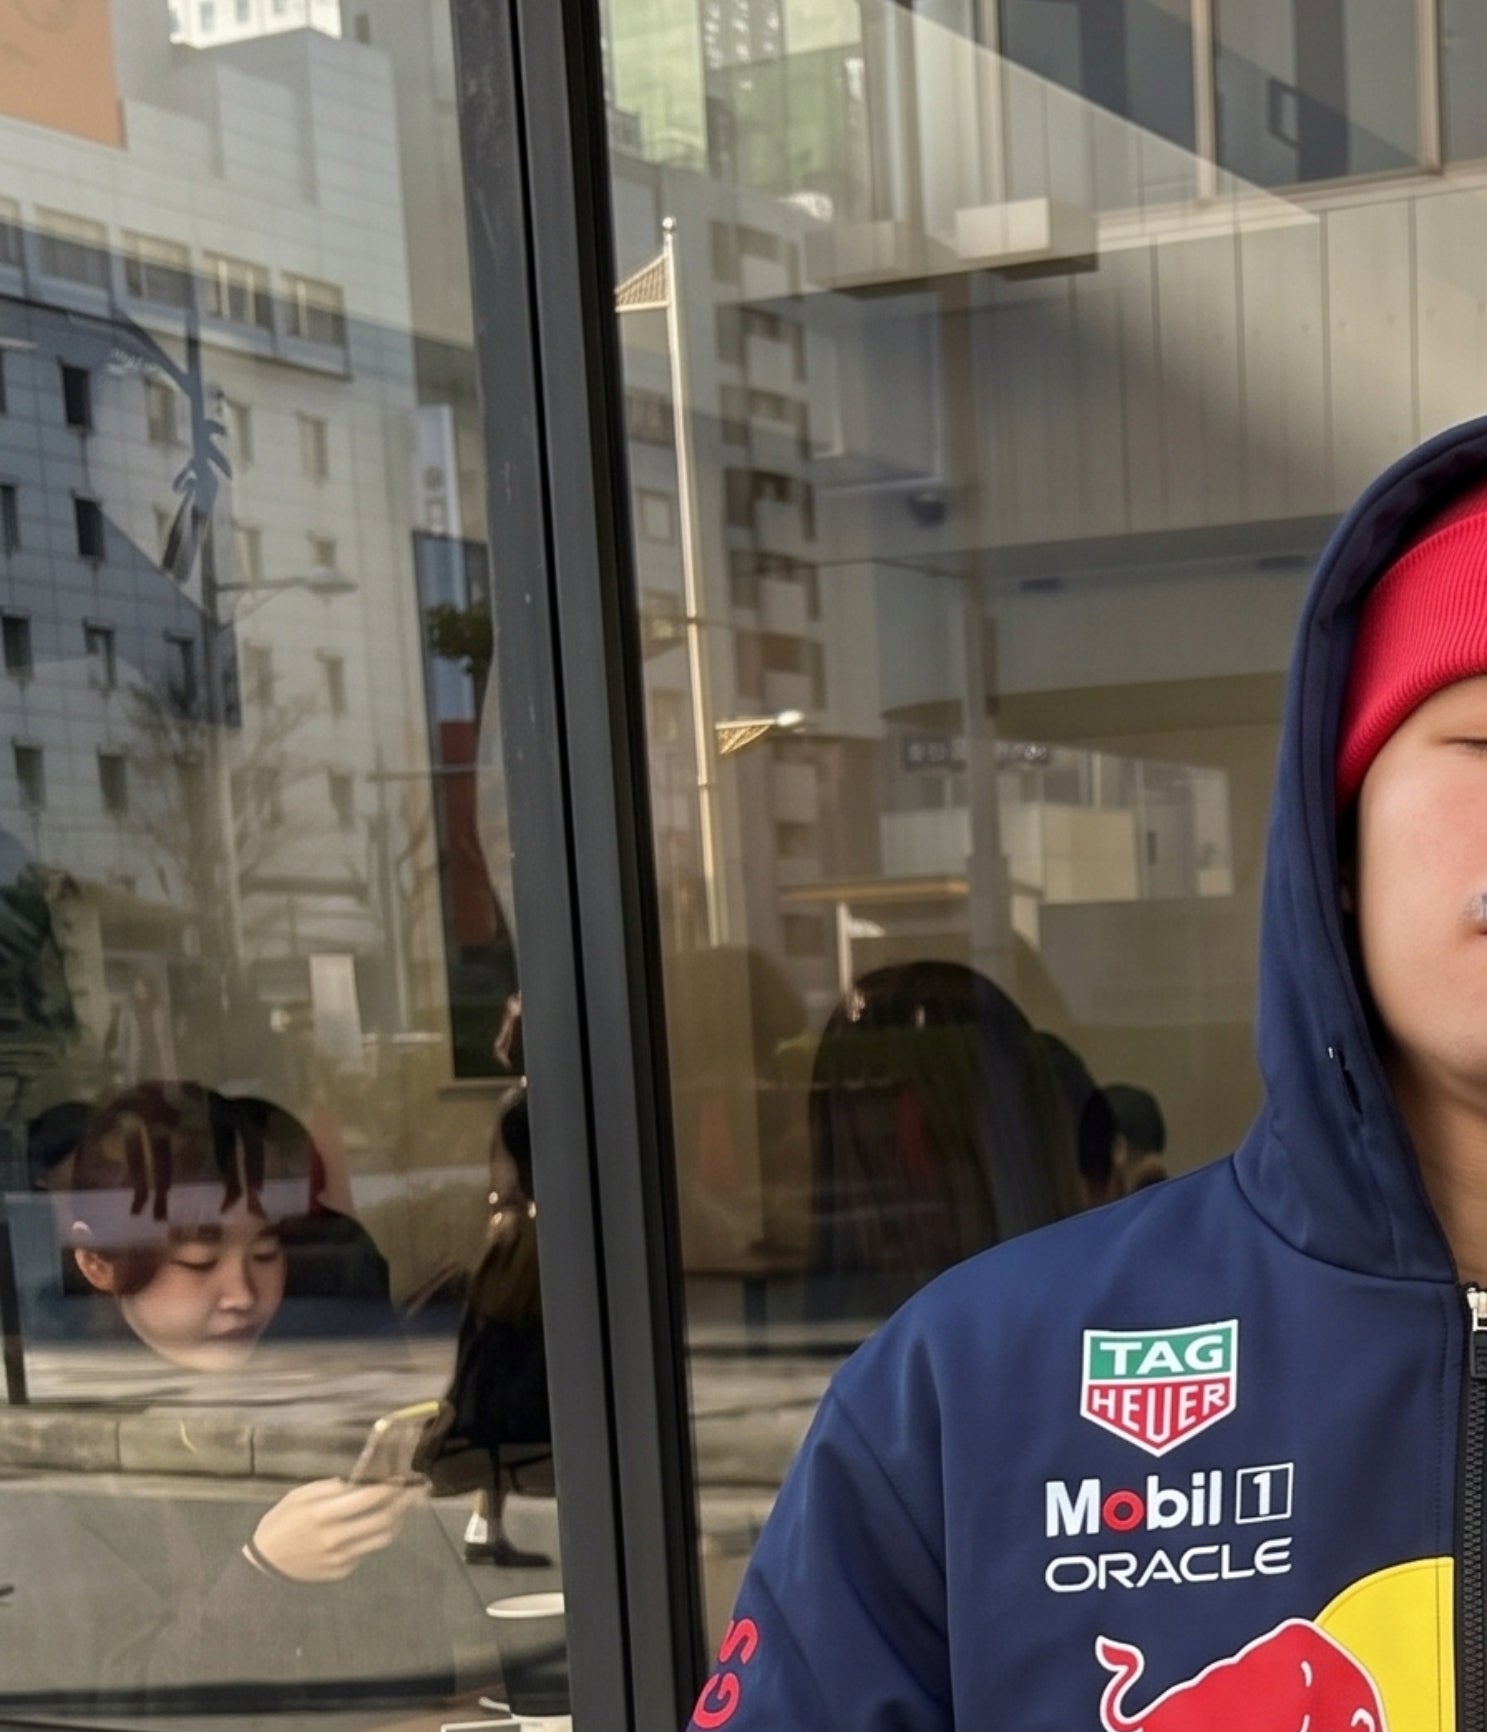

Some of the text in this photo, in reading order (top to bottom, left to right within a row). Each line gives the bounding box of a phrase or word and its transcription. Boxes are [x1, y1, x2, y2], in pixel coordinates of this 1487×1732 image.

[1099, 1333, 1224, 1376] TAG
[1091, 1381, 1227, 1445] HEUER
[1045, 1469, 1222, 1538] Mobil
[1044, 1536, 1293, 1593] ORACLE
